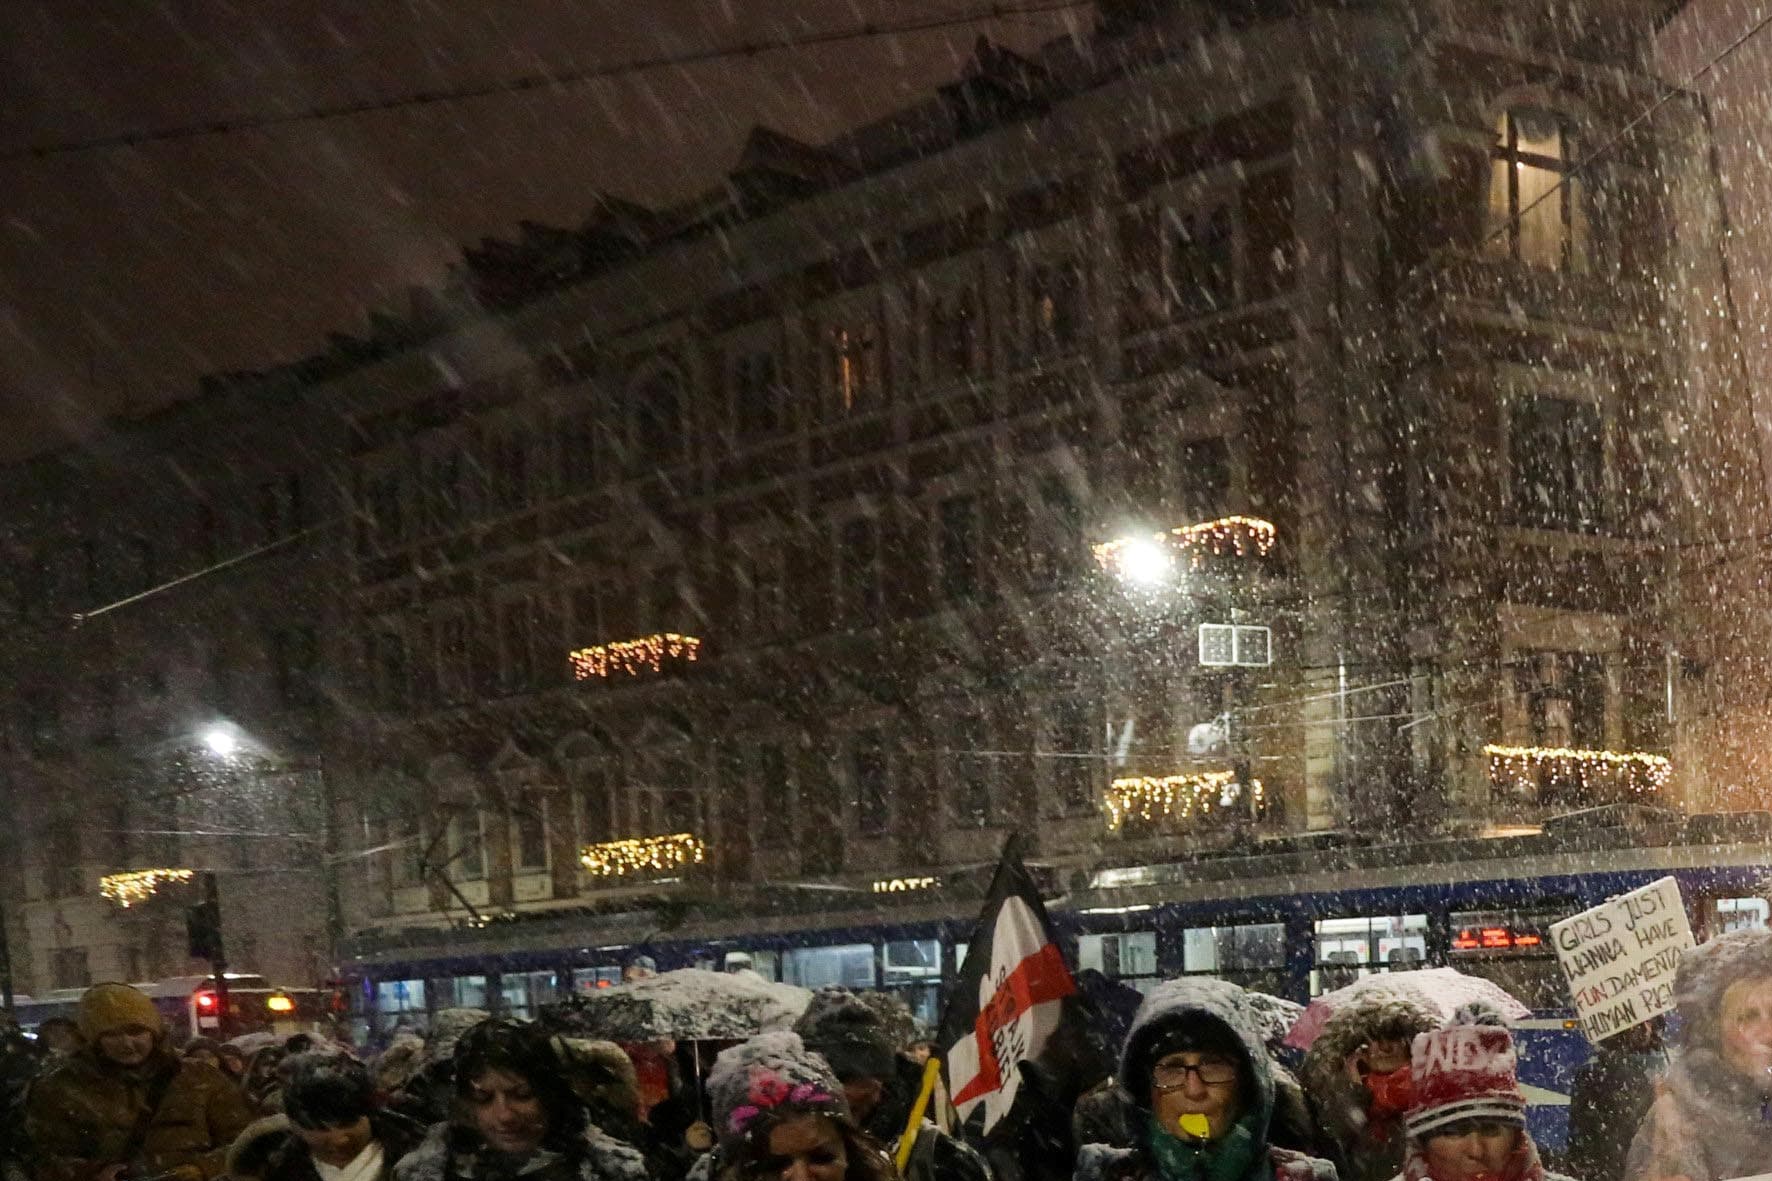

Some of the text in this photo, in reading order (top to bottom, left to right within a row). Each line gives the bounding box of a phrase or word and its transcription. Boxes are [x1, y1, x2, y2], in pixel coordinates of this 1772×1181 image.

[1558, 911, 1612, 951] GIRLS
[1618, 888, 1667, 931] JUST
[1563, 937, 1627, 981] WANNA
[1634, 918, 1678, 949] HAVE
[1583, 998, 1637, 1041] HUMAN
